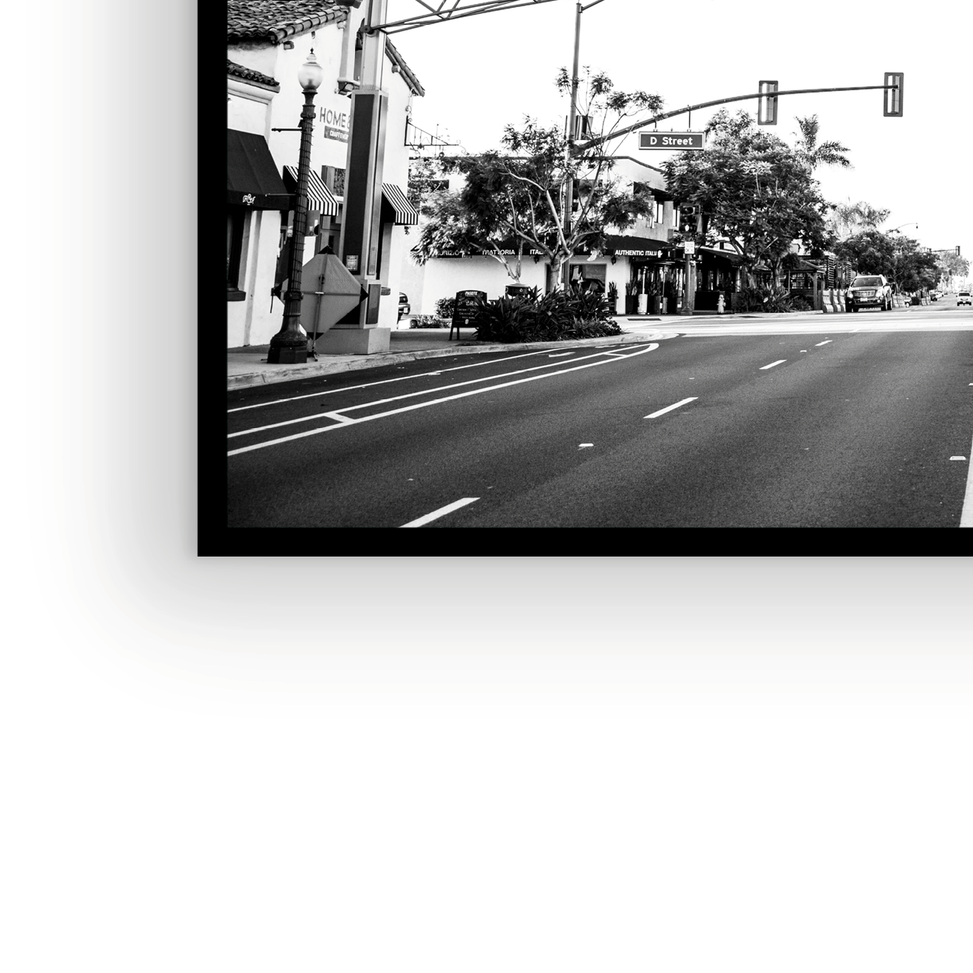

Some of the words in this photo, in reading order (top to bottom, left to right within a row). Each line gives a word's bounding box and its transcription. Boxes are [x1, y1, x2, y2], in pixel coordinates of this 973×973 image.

[319, 106, 347, 128] HOME
[650, 136, 658, 145] D
[662, 136, 693, 146] Street
